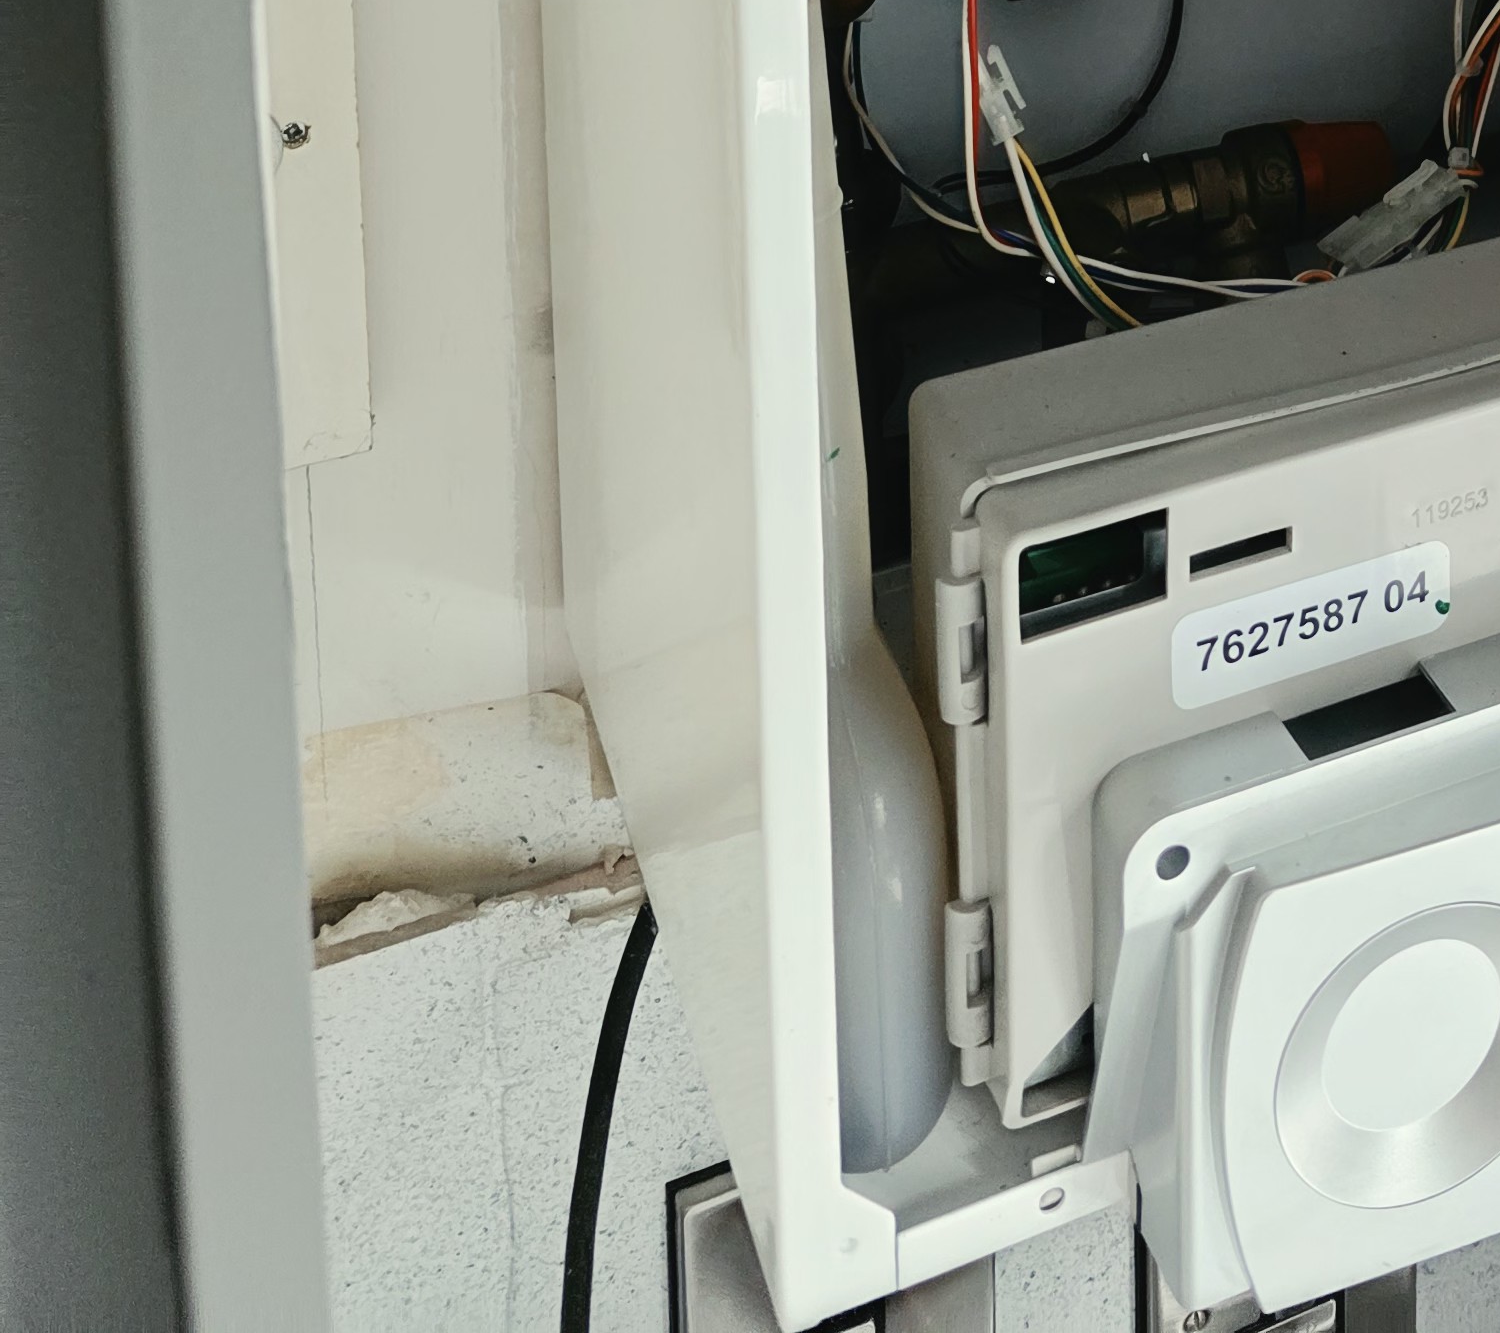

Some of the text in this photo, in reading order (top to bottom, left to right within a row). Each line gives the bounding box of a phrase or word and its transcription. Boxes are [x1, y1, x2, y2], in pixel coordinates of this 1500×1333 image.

[1411, 487, 1489, 528] 119253
[1196, 570, 1430, 671] 7627587 04
